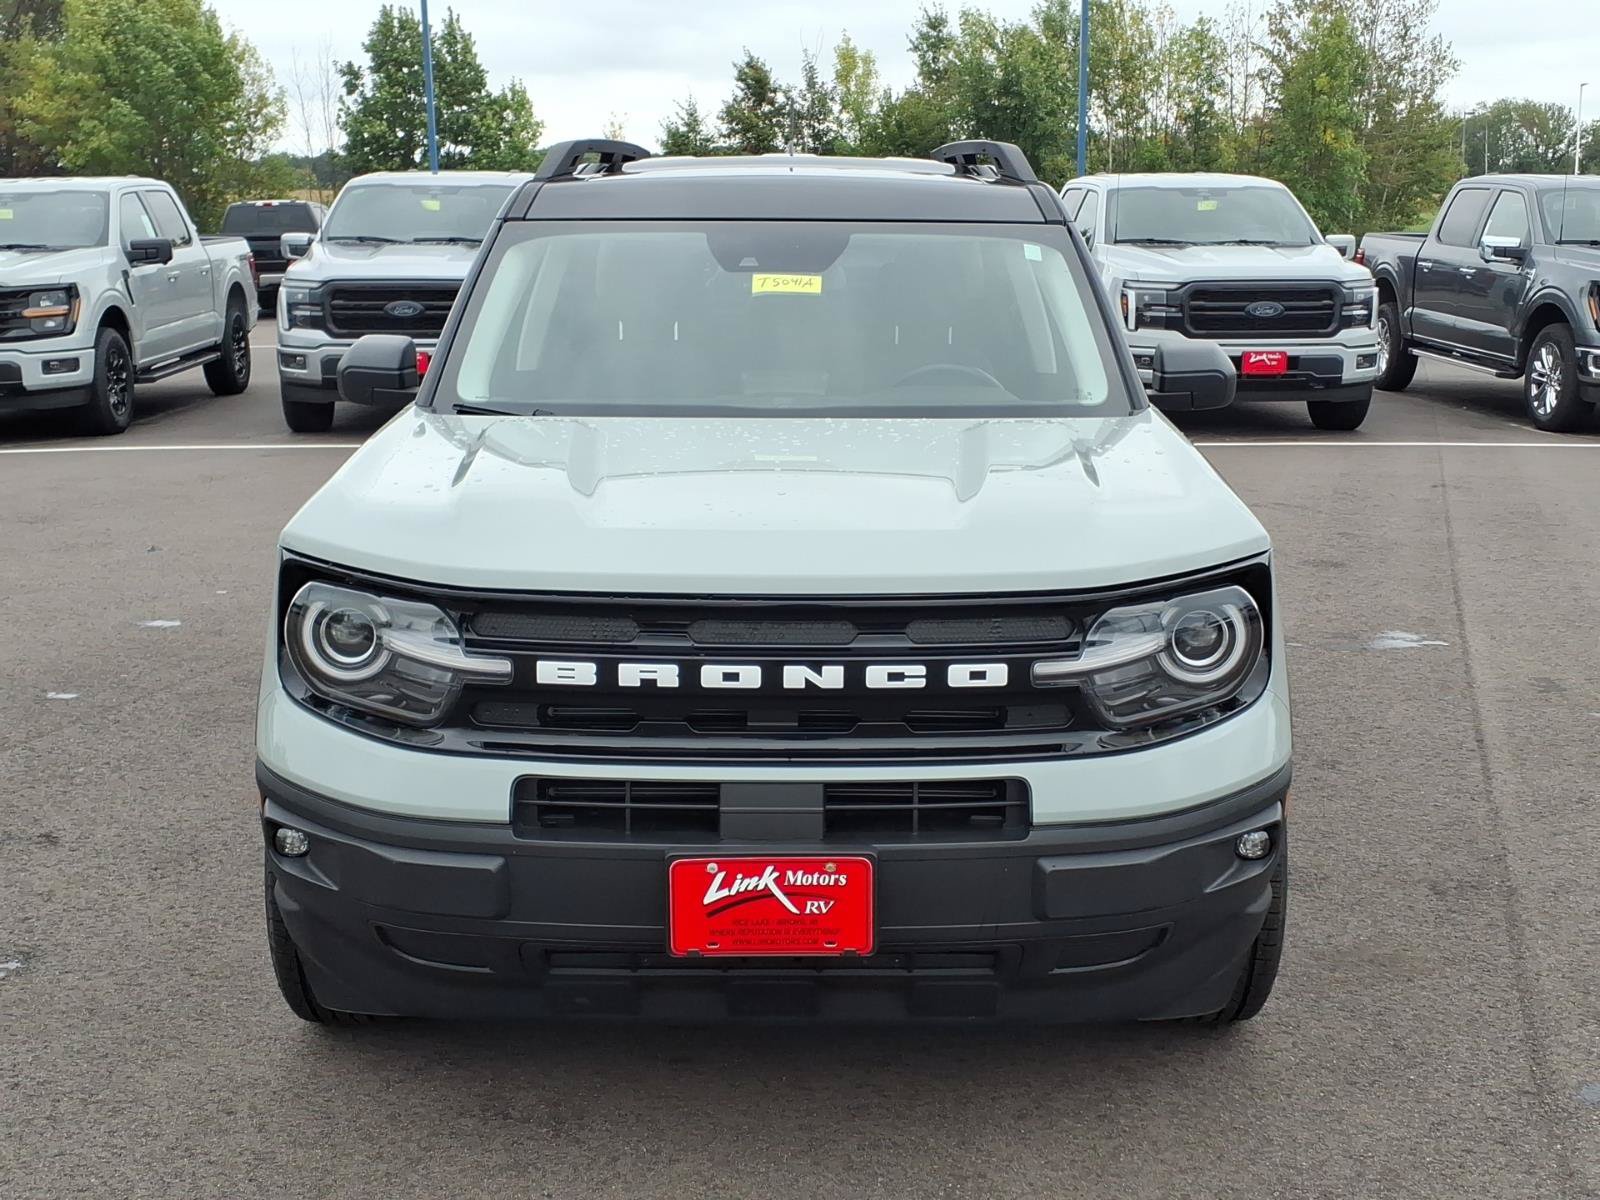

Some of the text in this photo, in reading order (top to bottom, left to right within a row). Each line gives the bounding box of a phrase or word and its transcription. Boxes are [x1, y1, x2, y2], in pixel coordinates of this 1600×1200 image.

[536, 660, 1008, 689] BRONCO
[703, 865, 847, 914] Link Motors
[804, 900, 834, 914] RV
